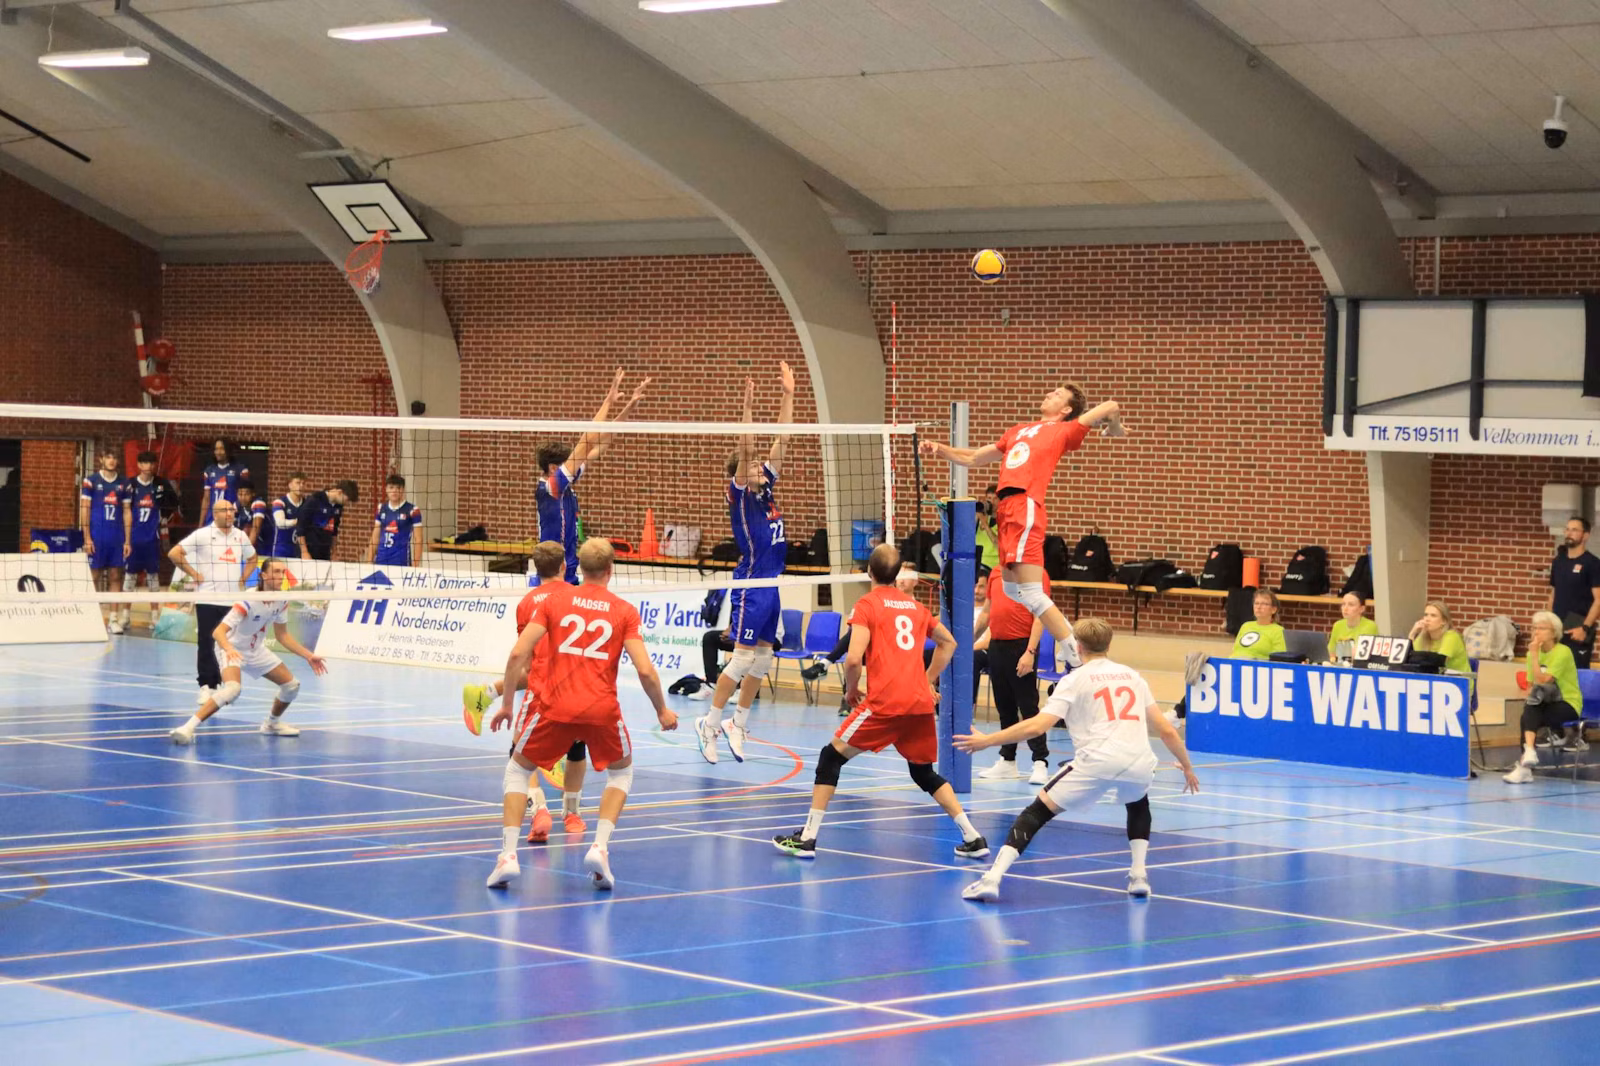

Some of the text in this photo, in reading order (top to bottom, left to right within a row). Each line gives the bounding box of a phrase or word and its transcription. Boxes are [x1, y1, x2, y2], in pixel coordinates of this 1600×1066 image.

[1368, 426, 1390, 441] Tlf.
[1483, 427, 1579, 446] Velkommen
[104, 504, 116, 521] 12
[139, 507, 151, 522] 17
[383, 532, 394, 548] 15
[402, 571, 428, 588] H.H.
[41, 603, 84, 617] apotek
[572, 596, 611, 613] MADSEN
[391, 610, 467, 633] Nordenskov
[558, 613, 613, 661] 22
[744, 629, 753, 639] 22
[895, 614, 915, 651] 8
[369, 645, 380, 657] 40
[380, 646, 391, 657] 27
[392, 648, 403, 659] 85
[404, 649, 415, 660] 90
[431, 651, 442, 663] 75
[443, 652, 455, 663] 29
[456, 654, 467, 665] 85
[469, 655, 480, 666] 90
[1359, 640, 1369, 657] 3
[1392, 643, 1404, 661] 2
[666, 653, 682, 670] 24
[1089, 672, 1133, 683] PETERSEN
[1093, 686, 1140, 721] 12
[1190, 662, 1465, 738] BLUE WATER
